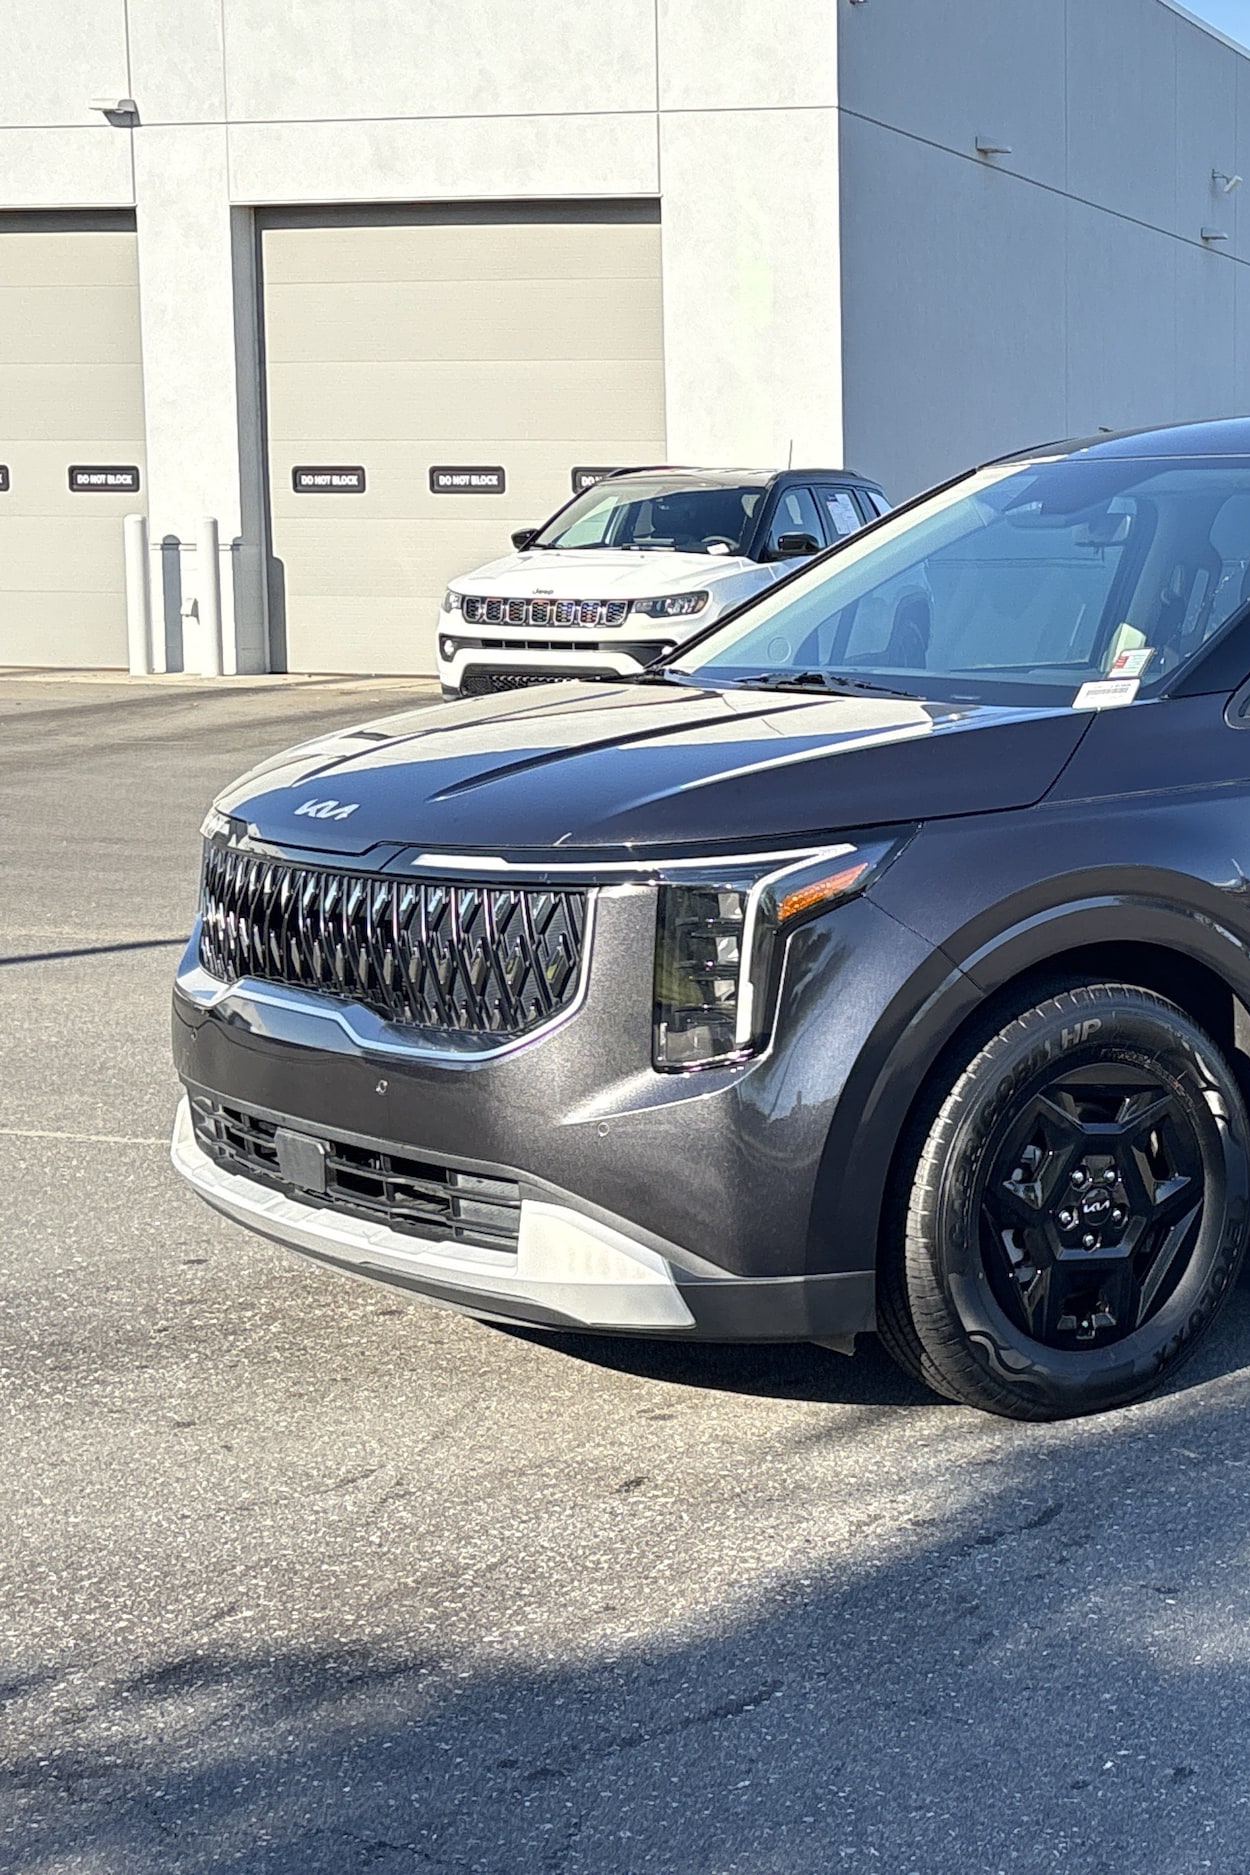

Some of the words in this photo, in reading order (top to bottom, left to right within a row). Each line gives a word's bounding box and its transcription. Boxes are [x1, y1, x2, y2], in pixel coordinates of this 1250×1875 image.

[77, 474, 90, 485] DO
[90, 474, 106, 485] NOT
[107, 474, 133, 485] BLOCK
[301, 475, 314, 485] DO
[315, 475, 331, 485] NOT
[332, 475, 359, 486] BLOCK
[438, 475, 452, 486] DO
[453, 475, 470, 486] NOT
[471, 475, 498, 486] BLOCK
[293, 798, 361, 821] KIA
[1061, 1018, 1102, 1050] HP
